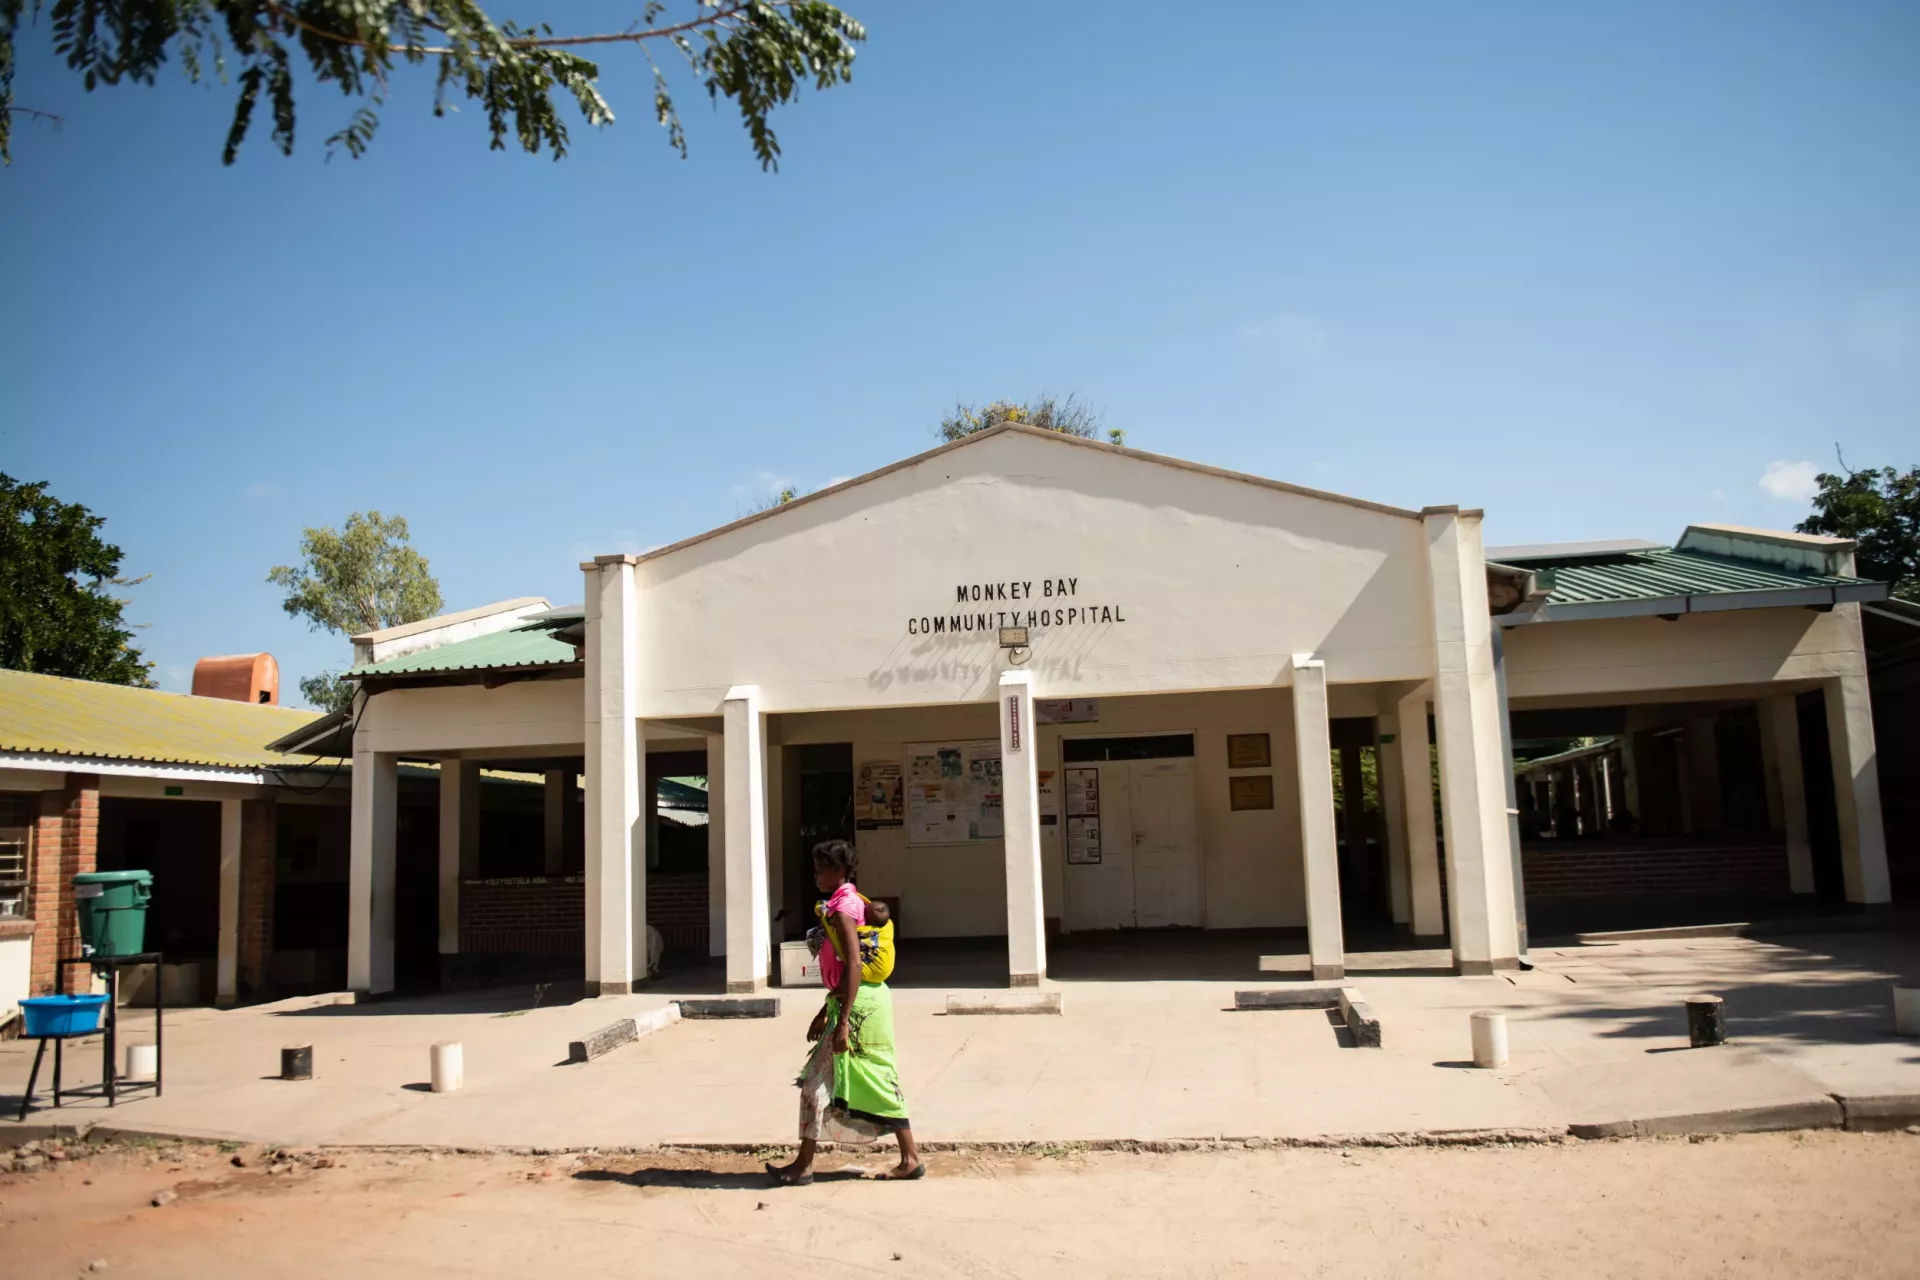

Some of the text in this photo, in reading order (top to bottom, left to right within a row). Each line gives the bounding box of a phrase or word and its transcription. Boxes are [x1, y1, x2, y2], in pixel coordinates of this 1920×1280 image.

[957, 577, 1078, 602] MONKEY BAY
[908, 605, 1126, 635] COMMUNITY HOSPITAL
